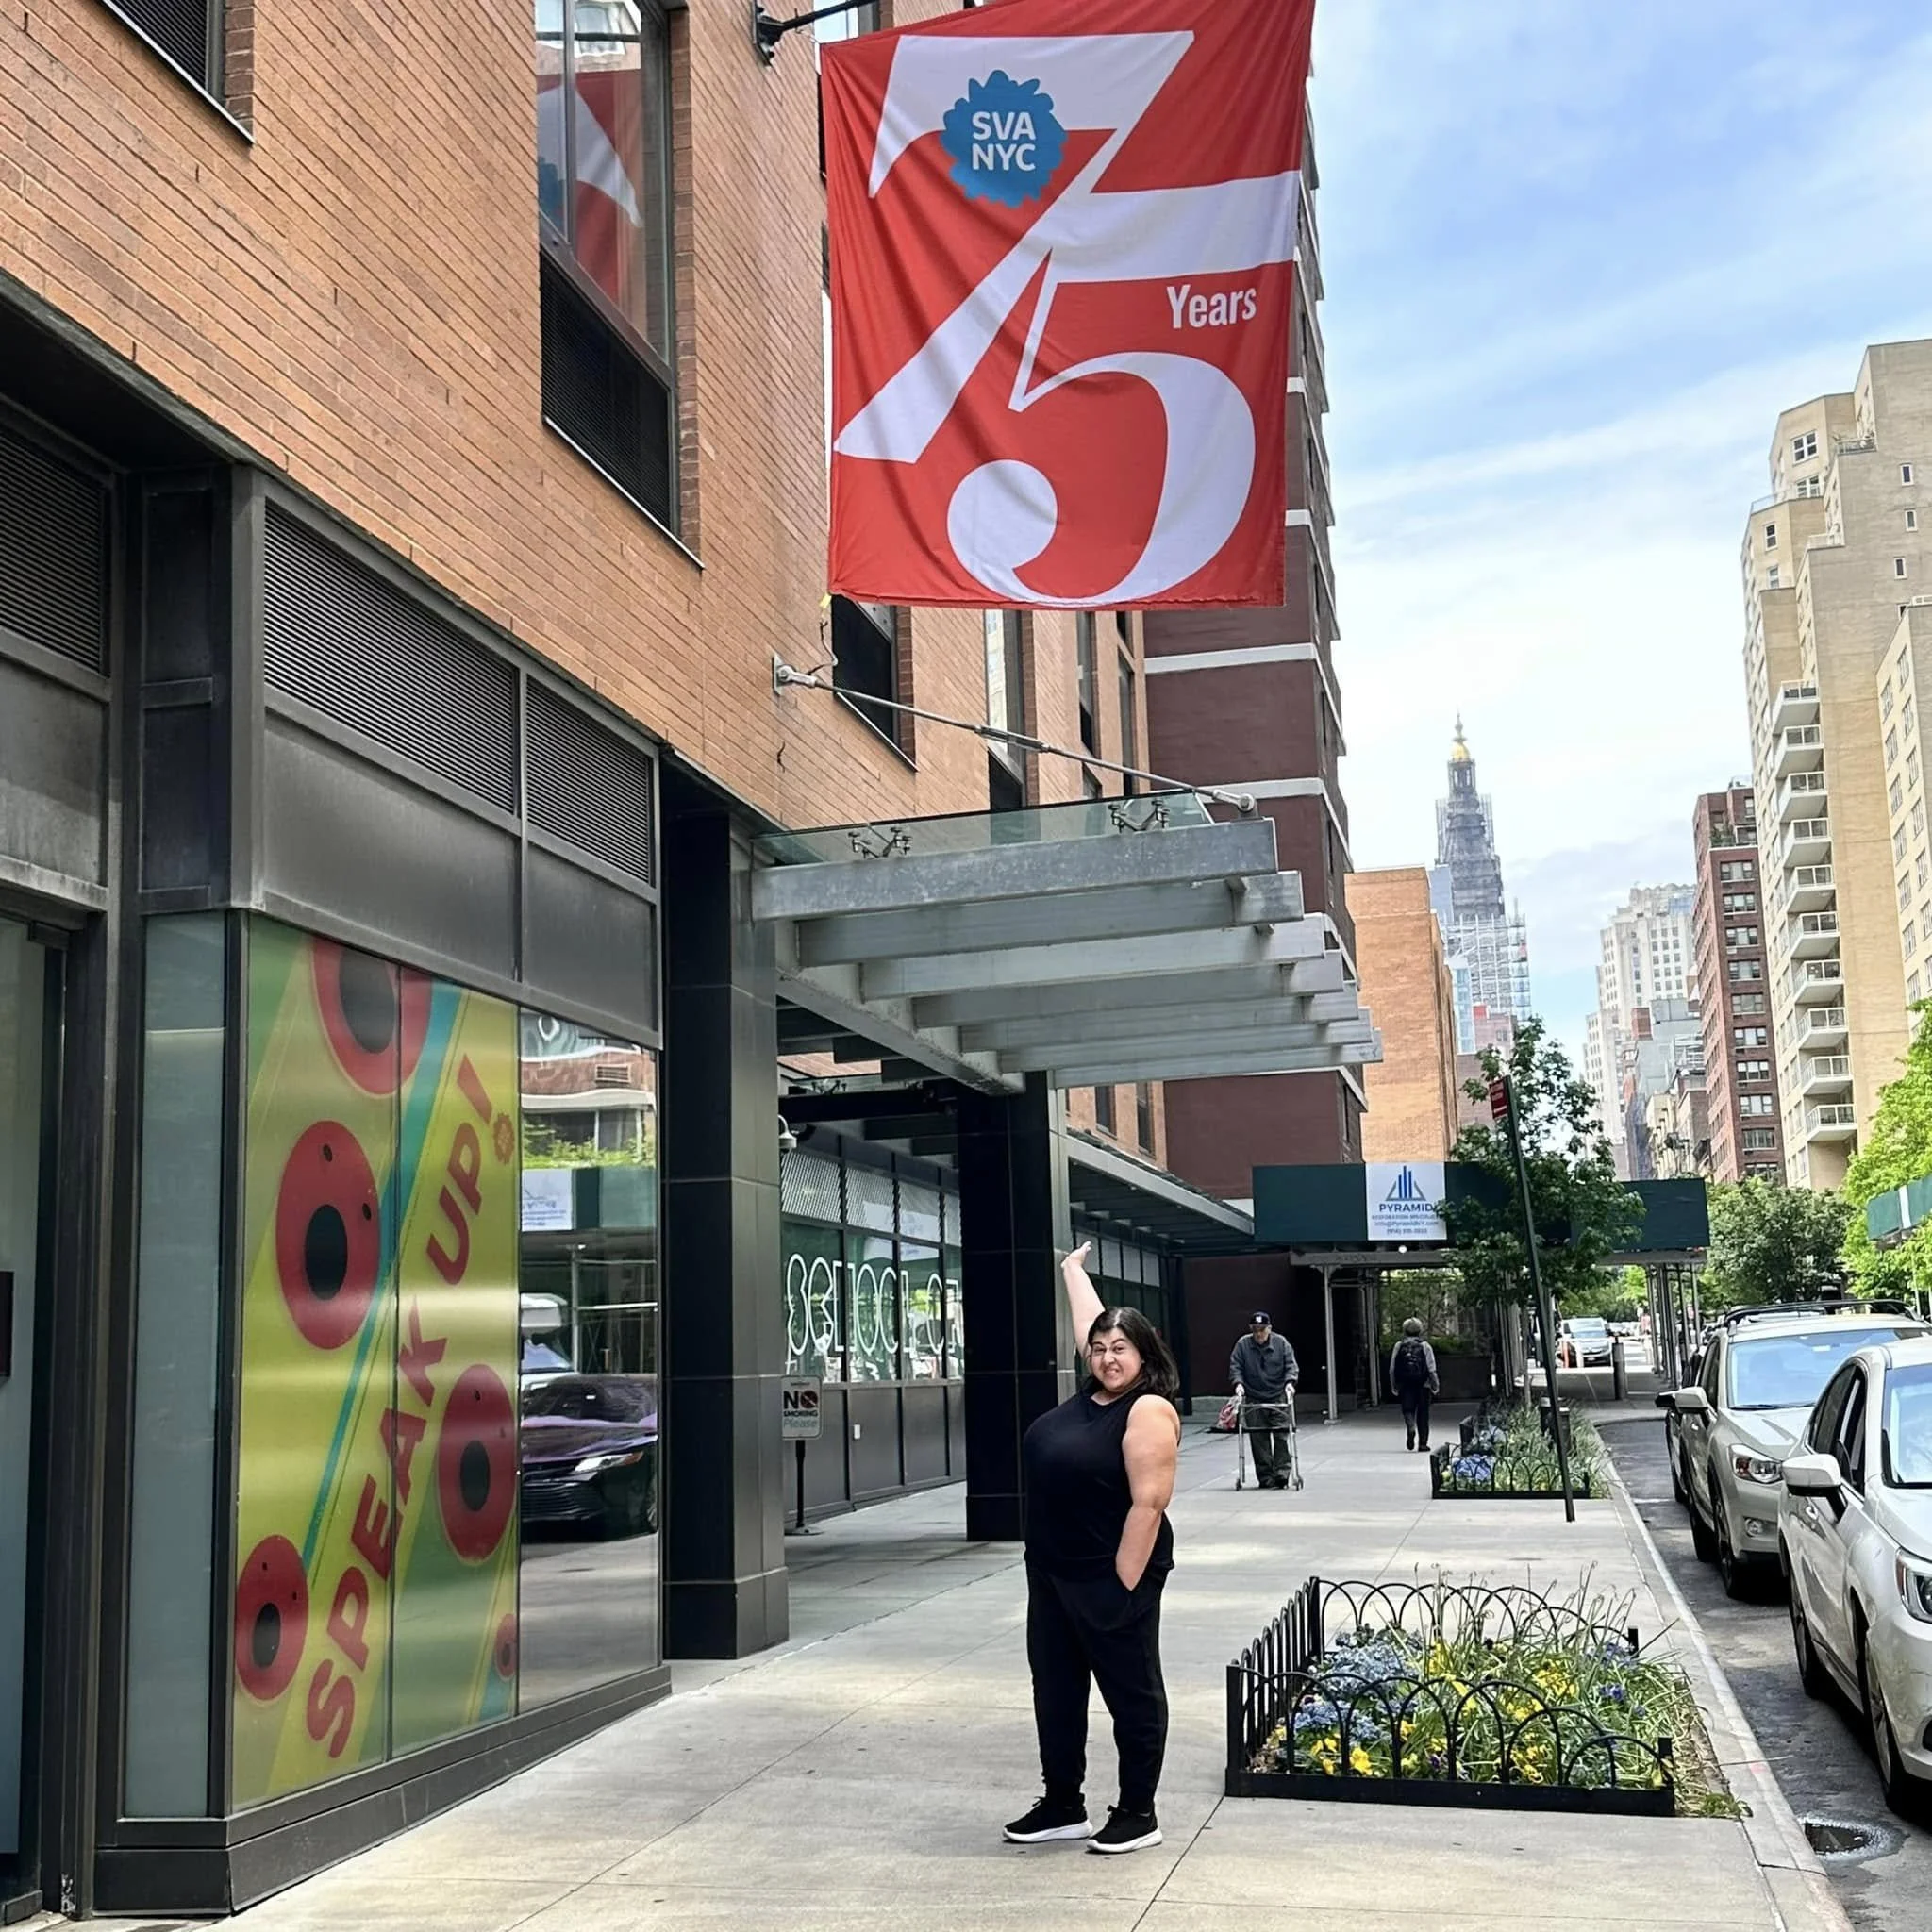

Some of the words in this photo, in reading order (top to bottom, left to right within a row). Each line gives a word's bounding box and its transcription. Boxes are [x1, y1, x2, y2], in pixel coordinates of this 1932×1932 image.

[972, 112, 1036, 141] SVA
[972, 144, 1036, 171] NYC
[834, 30, 1302, 606] 75
[1167, 285, 1257, 328] Years
[1379, 1203, 1433, 1212] PYRAMID
[306, 1294, 447, 1758] SPEAK
[426, 1053, 515, 1285] UP!
